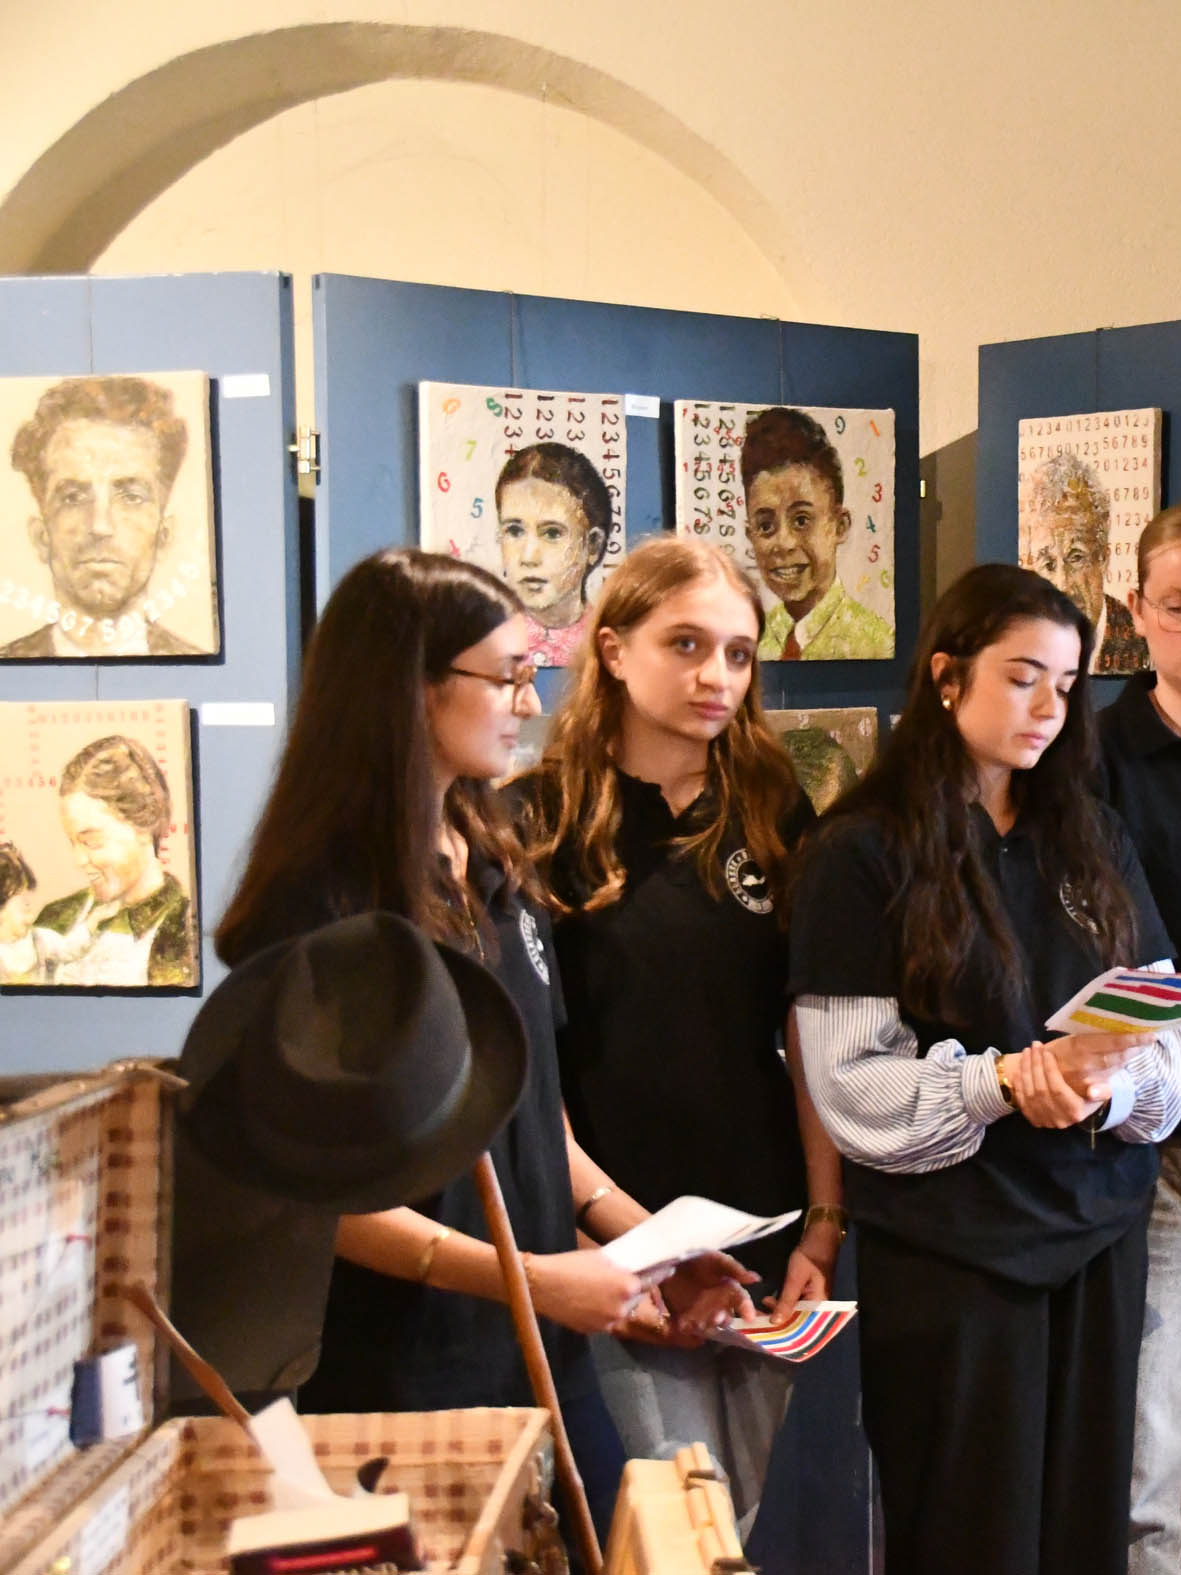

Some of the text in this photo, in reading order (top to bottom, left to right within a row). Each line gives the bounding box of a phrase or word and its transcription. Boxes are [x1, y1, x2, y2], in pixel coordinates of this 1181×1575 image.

[854, 457, 867, 476] 2
[437, 471, 451, 493] 6
[872, 483, 883, 503] 3
[470, 497, 483, 519] 5
[865, 514, 877, 533] 4
[868, 544, 881, 563] 5
